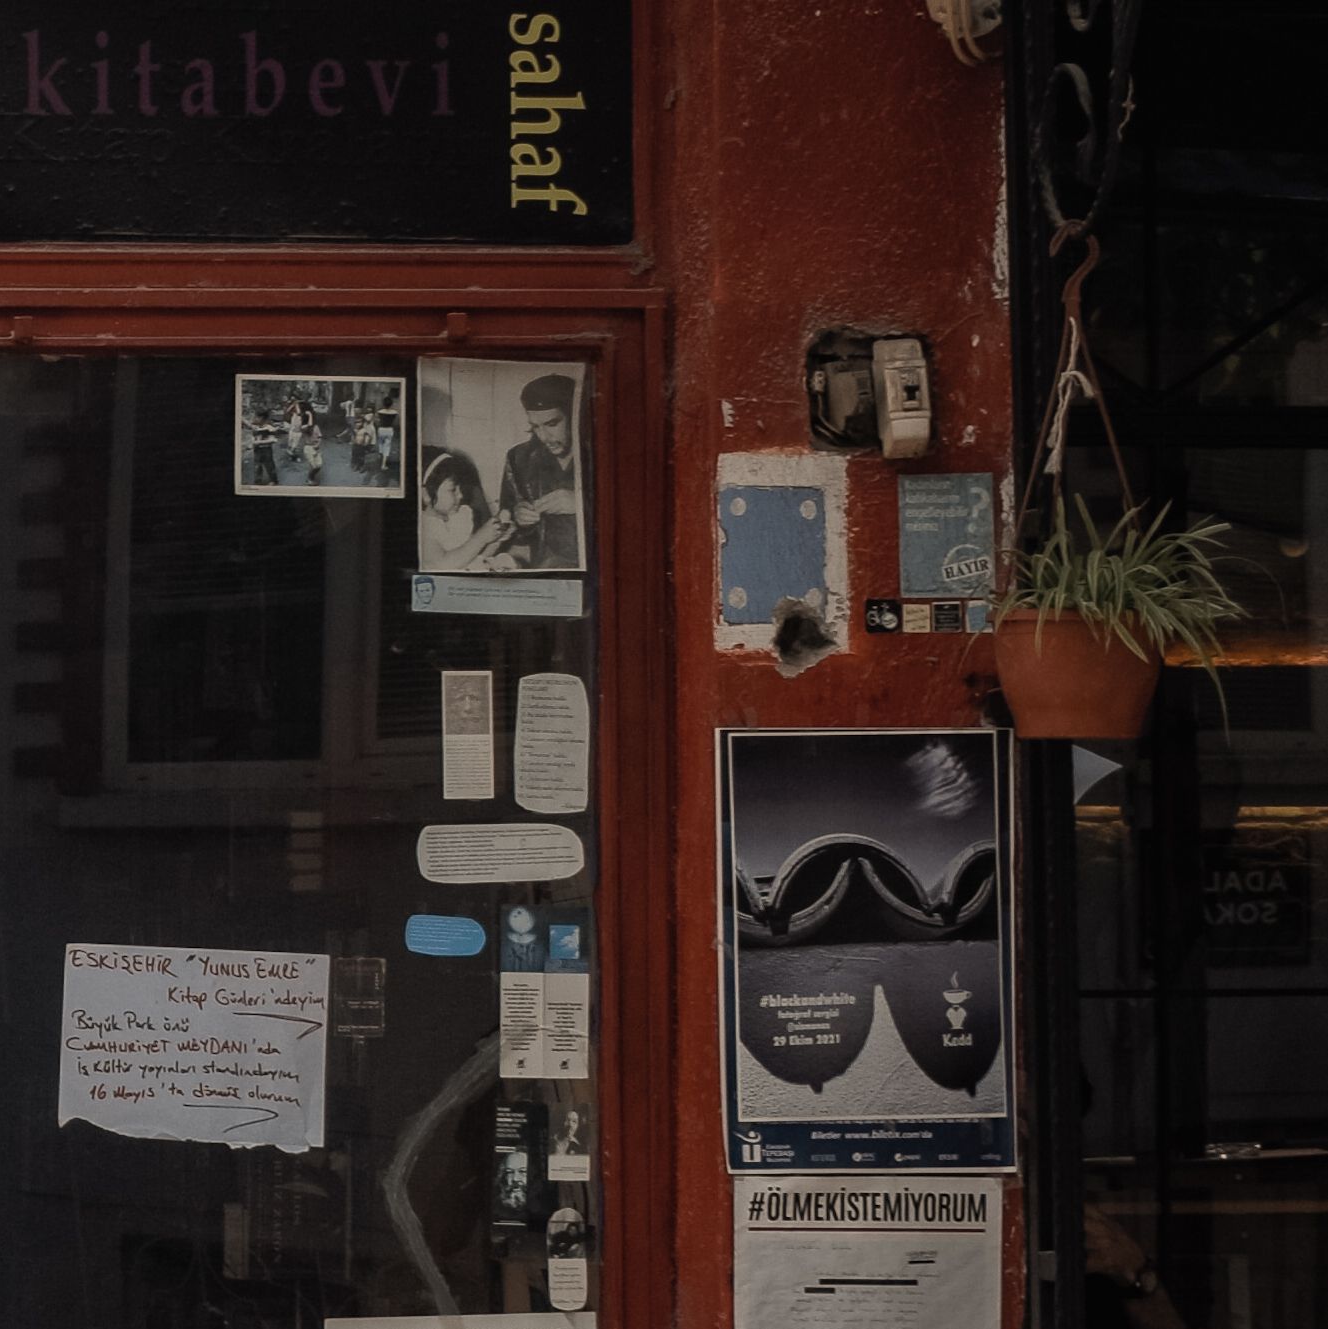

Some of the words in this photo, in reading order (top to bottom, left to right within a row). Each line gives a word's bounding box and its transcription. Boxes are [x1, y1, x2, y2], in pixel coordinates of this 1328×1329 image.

[23, 30, 455, 118] kitabevi
[509, 12, 588, 217] sahaf
[944, 558, 990, 581] HAYIR
[69, 949, 179, 979] ESKİŞEHİR
[167, 987, 208, 1009] Kitap
[71, 1009, 120, 1040] Büyük
[124, 1011, 156, 1032] Park
[163, 1016, 190, 1033] önü
[772, 1035, 787, 1047] 29
[789, 1034, 814, 1046] Ekim
[816, 1033, 841, 1046] 2021
[89, 1083, 107, 1101] 16
[748, 1186, 988, 1222] #ÖLMEKİSTEMİYORUM
